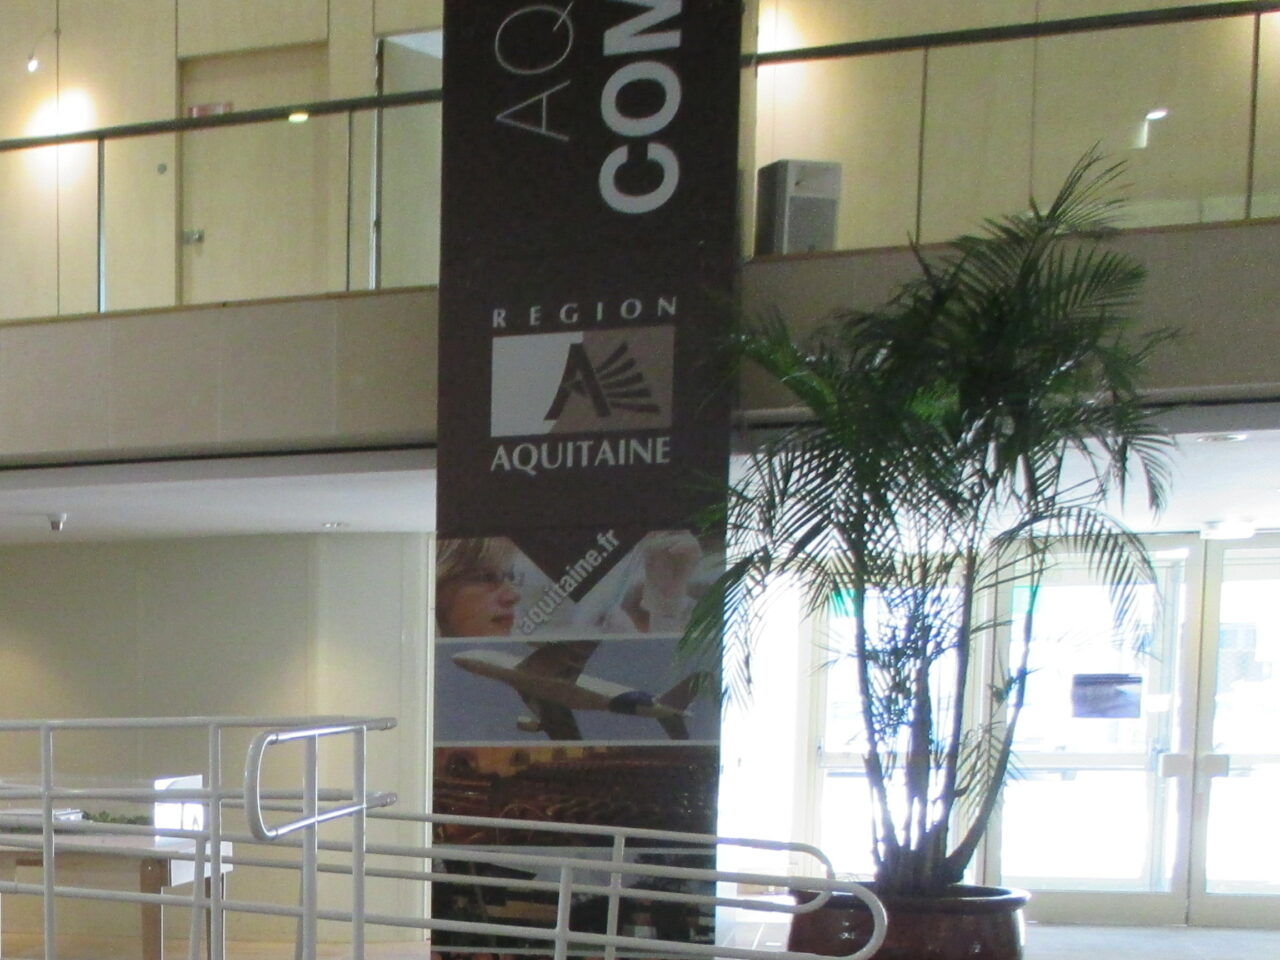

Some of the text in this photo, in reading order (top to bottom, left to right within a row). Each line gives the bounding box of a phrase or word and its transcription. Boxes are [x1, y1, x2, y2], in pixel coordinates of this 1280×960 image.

[492, 296, 677, 329] REGION
[489, 436, 671, 476] AQUITAINE
[522, 529, 620, 635] aquitaine.fr
